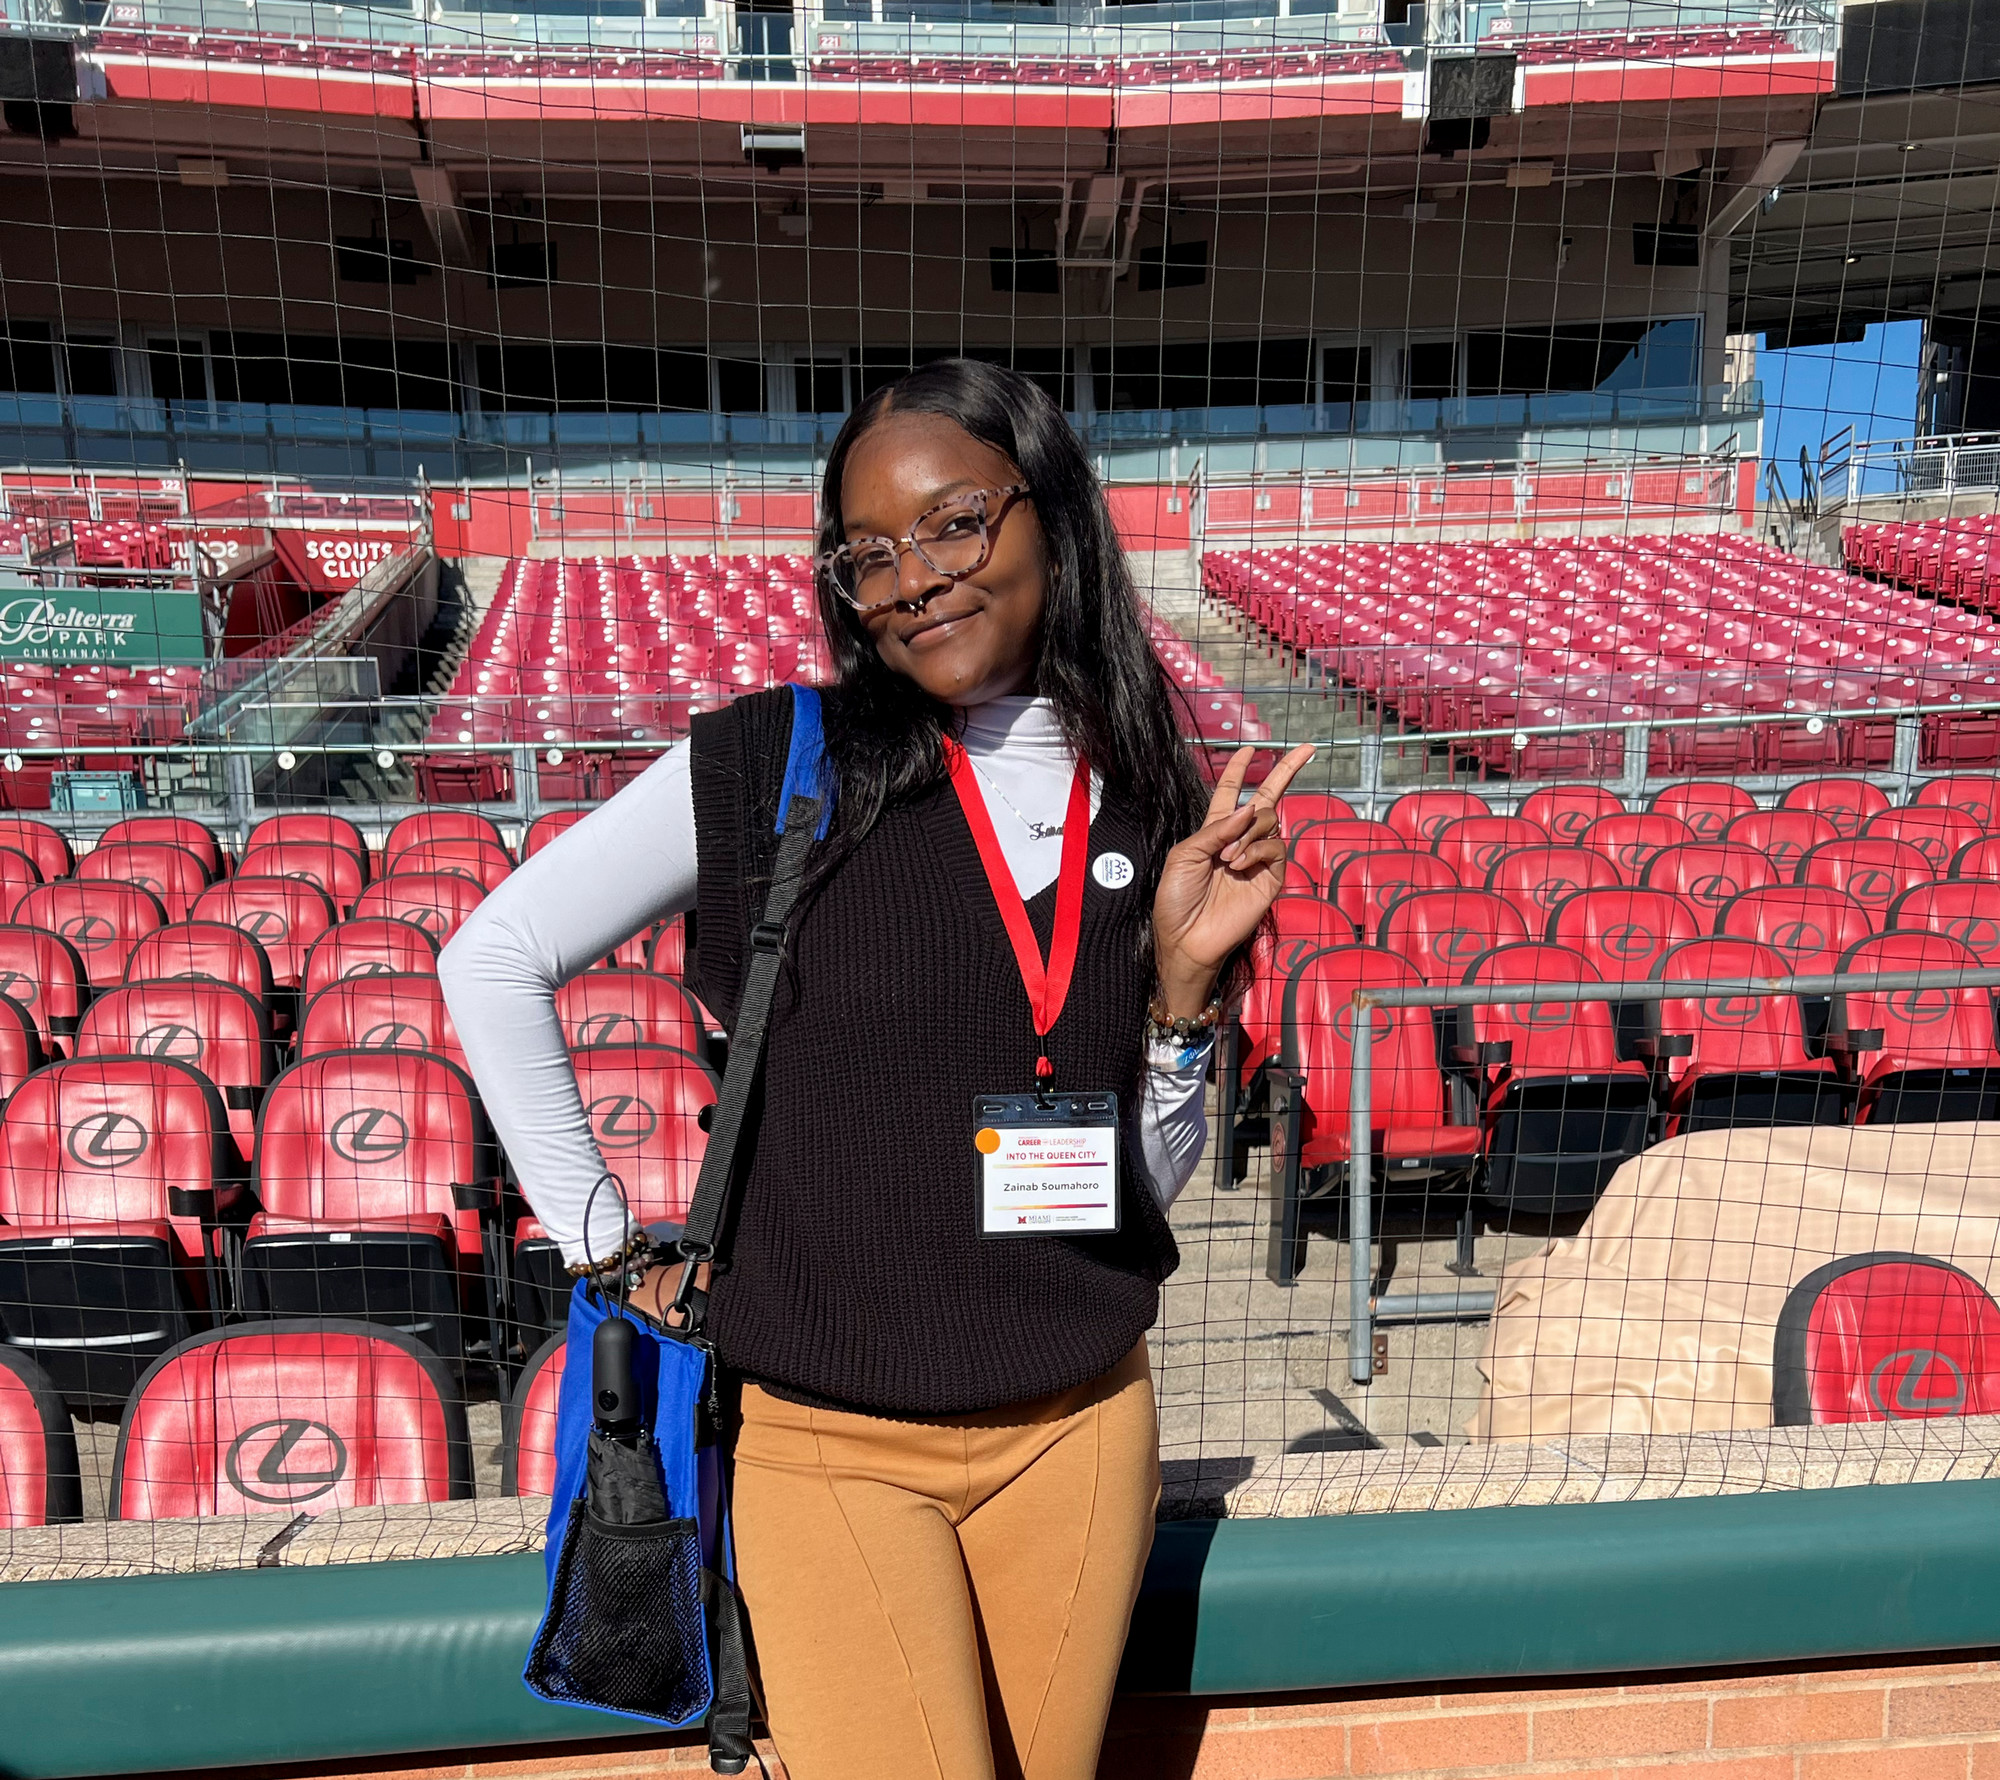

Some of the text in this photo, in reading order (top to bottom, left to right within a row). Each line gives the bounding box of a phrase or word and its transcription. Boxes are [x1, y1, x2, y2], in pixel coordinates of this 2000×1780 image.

[116, 5, 138, 17] 222
[1491, 20, 1513, 31] 220
[821, 36, 839, 47] 221
[162, 479, 181, 491] 122
[306, 540, 393, 560] SCOUTS
[0, 598, 136, 645] Belterra
[59, 631, 127, 646] PARK
[23, 647, 116, 659] CINCINNATI
[1006, 1151, 1097, 1160] INTO THE QUEEN CITY
[1003, 1181, 1100, 1192] Zainab Soumahoro
